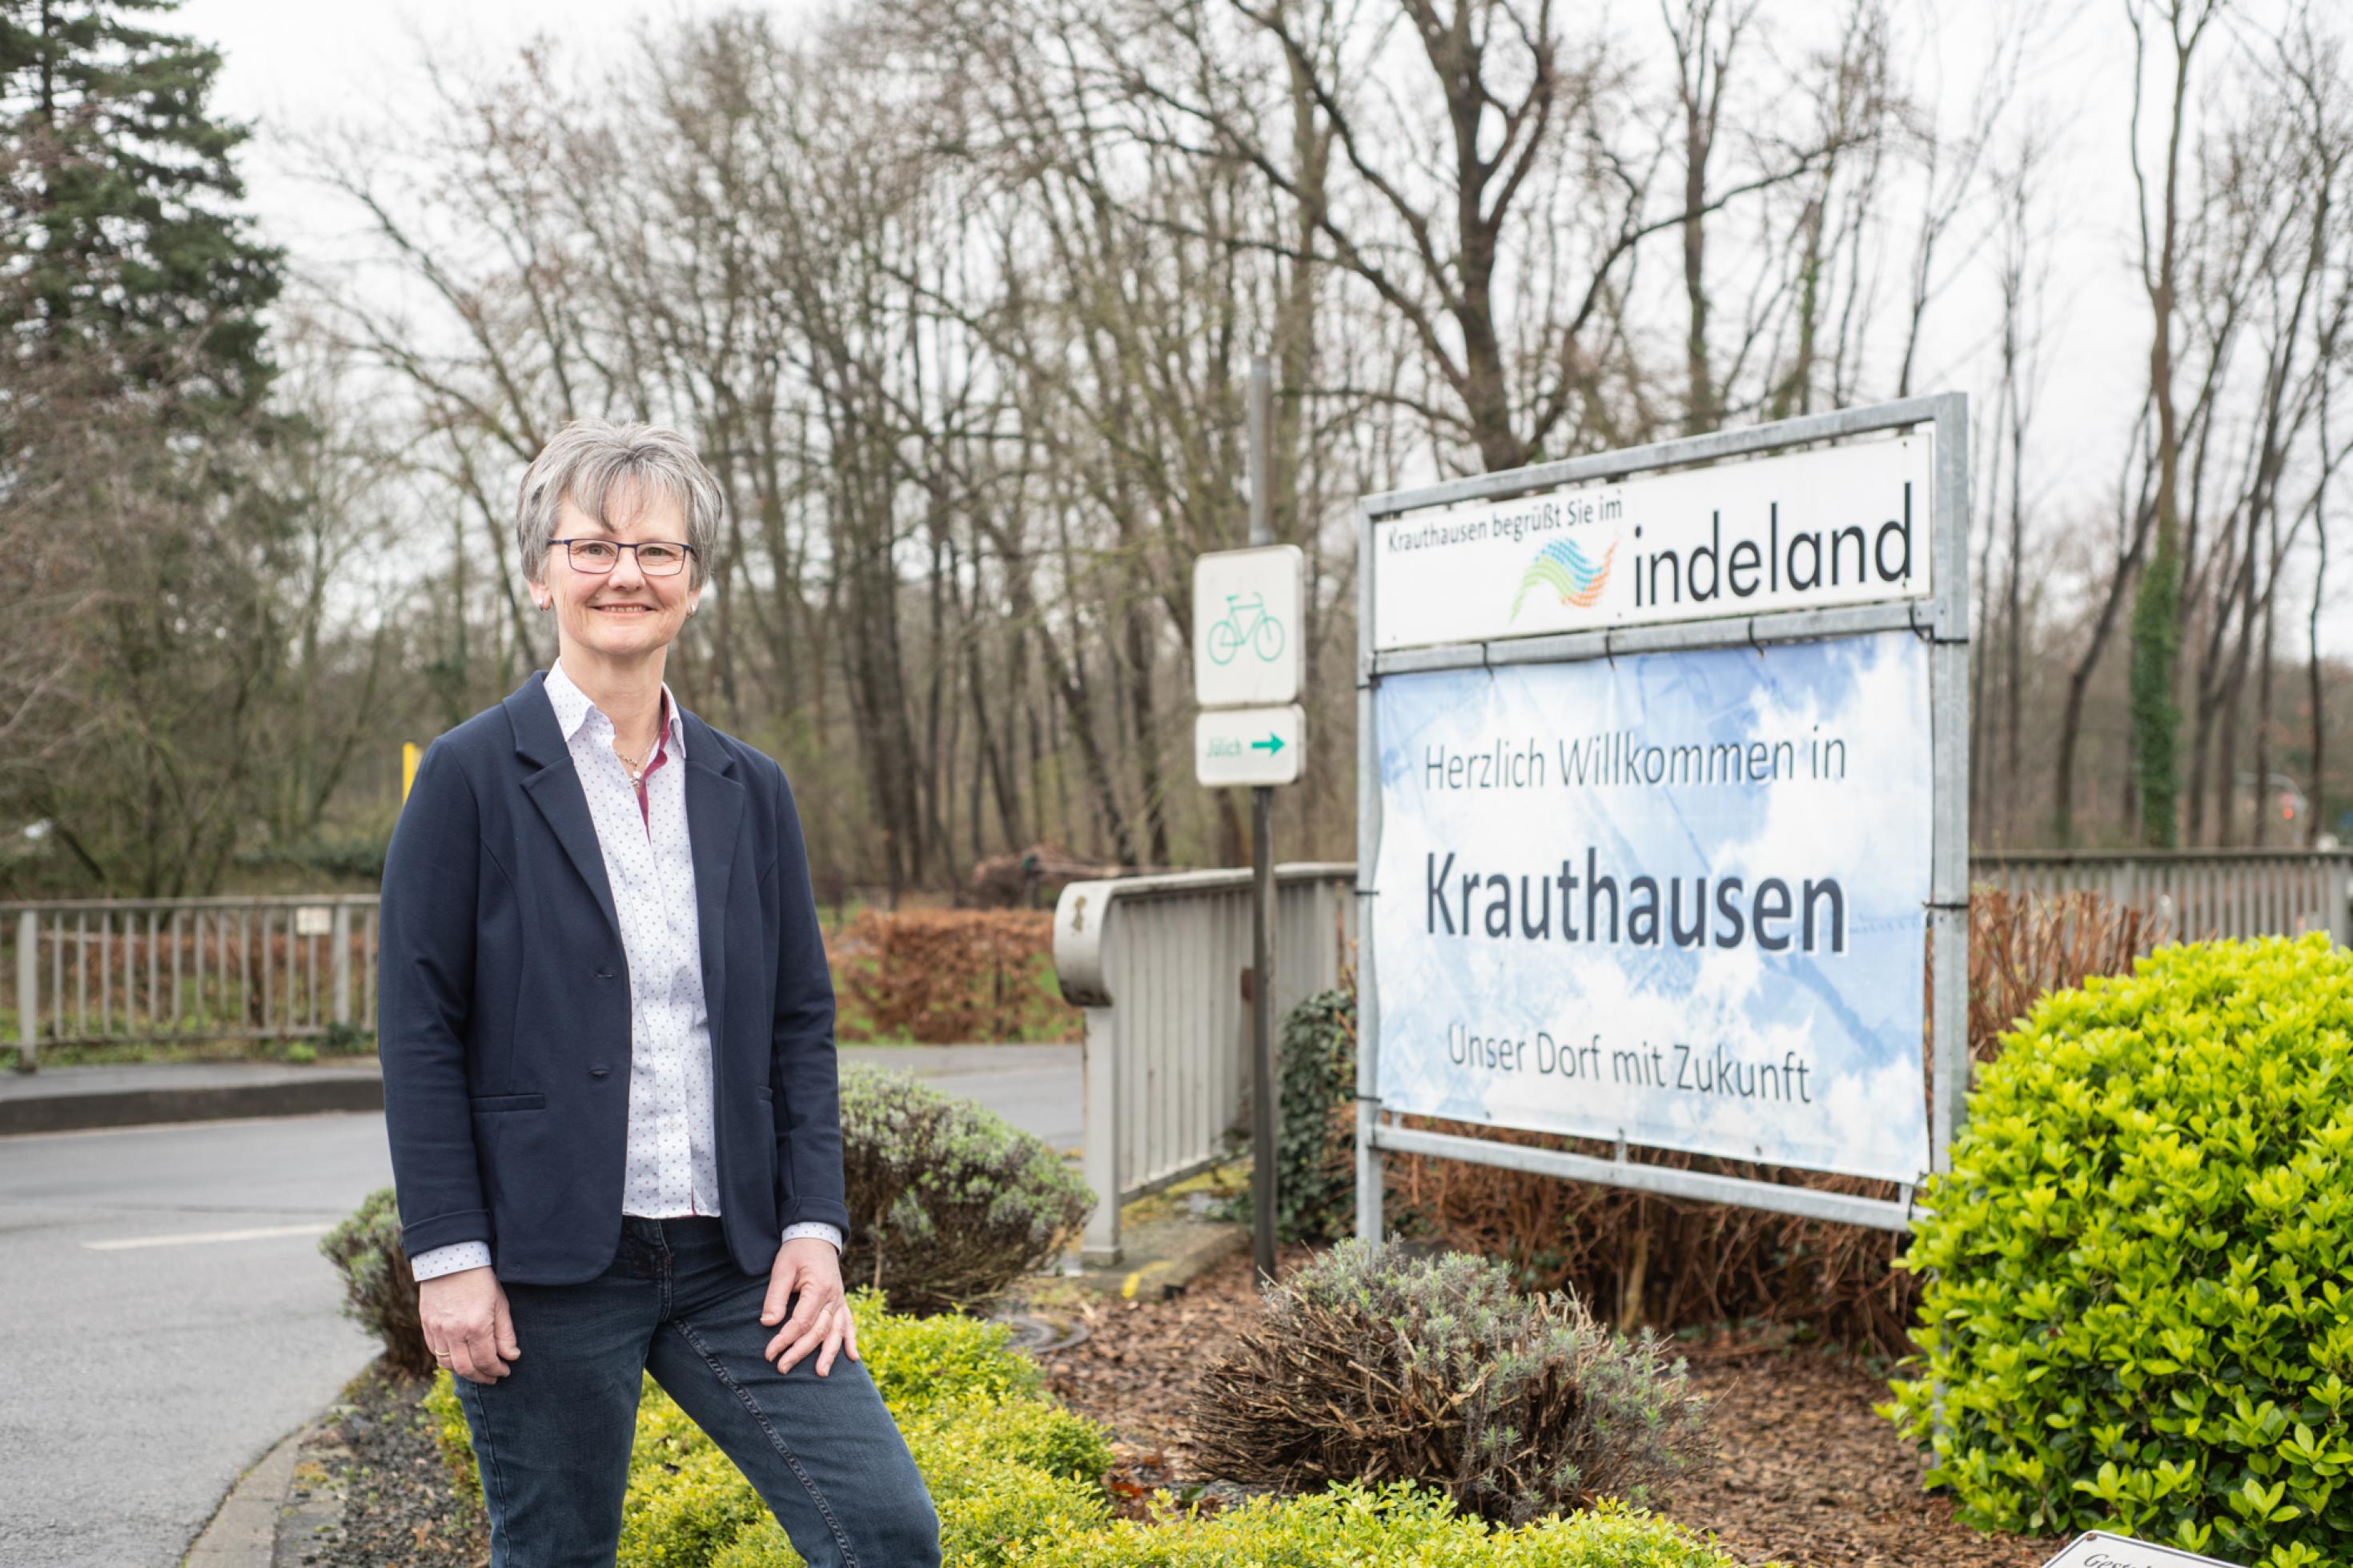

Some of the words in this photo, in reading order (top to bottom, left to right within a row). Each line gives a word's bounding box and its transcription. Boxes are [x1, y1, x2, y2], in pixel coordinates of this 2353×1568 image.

[1388, 521, 1488, 552] Krauthausen
[1493, 503, 1561, 542] begrüßt
[1567, 499, 1593, 525] Sie
[1599, 490, 1622, 519] im
[1634, 482, 1912, 607] indeland
[1426, 737, 1545, 790] Herzlich
[1559, 732, 1795, 787] Willkommen
[1811, 726, 1846, 780] in
[1427, 847, 1847, 953] Krauthausen
[1449, 1025, 1524, 1073] Unser
[1537, 1033, 1602, 1080] Dorf
[1613, 1042, 1666, 1089] mit
[1675, 1045, 1812, 1105] Zukunft
